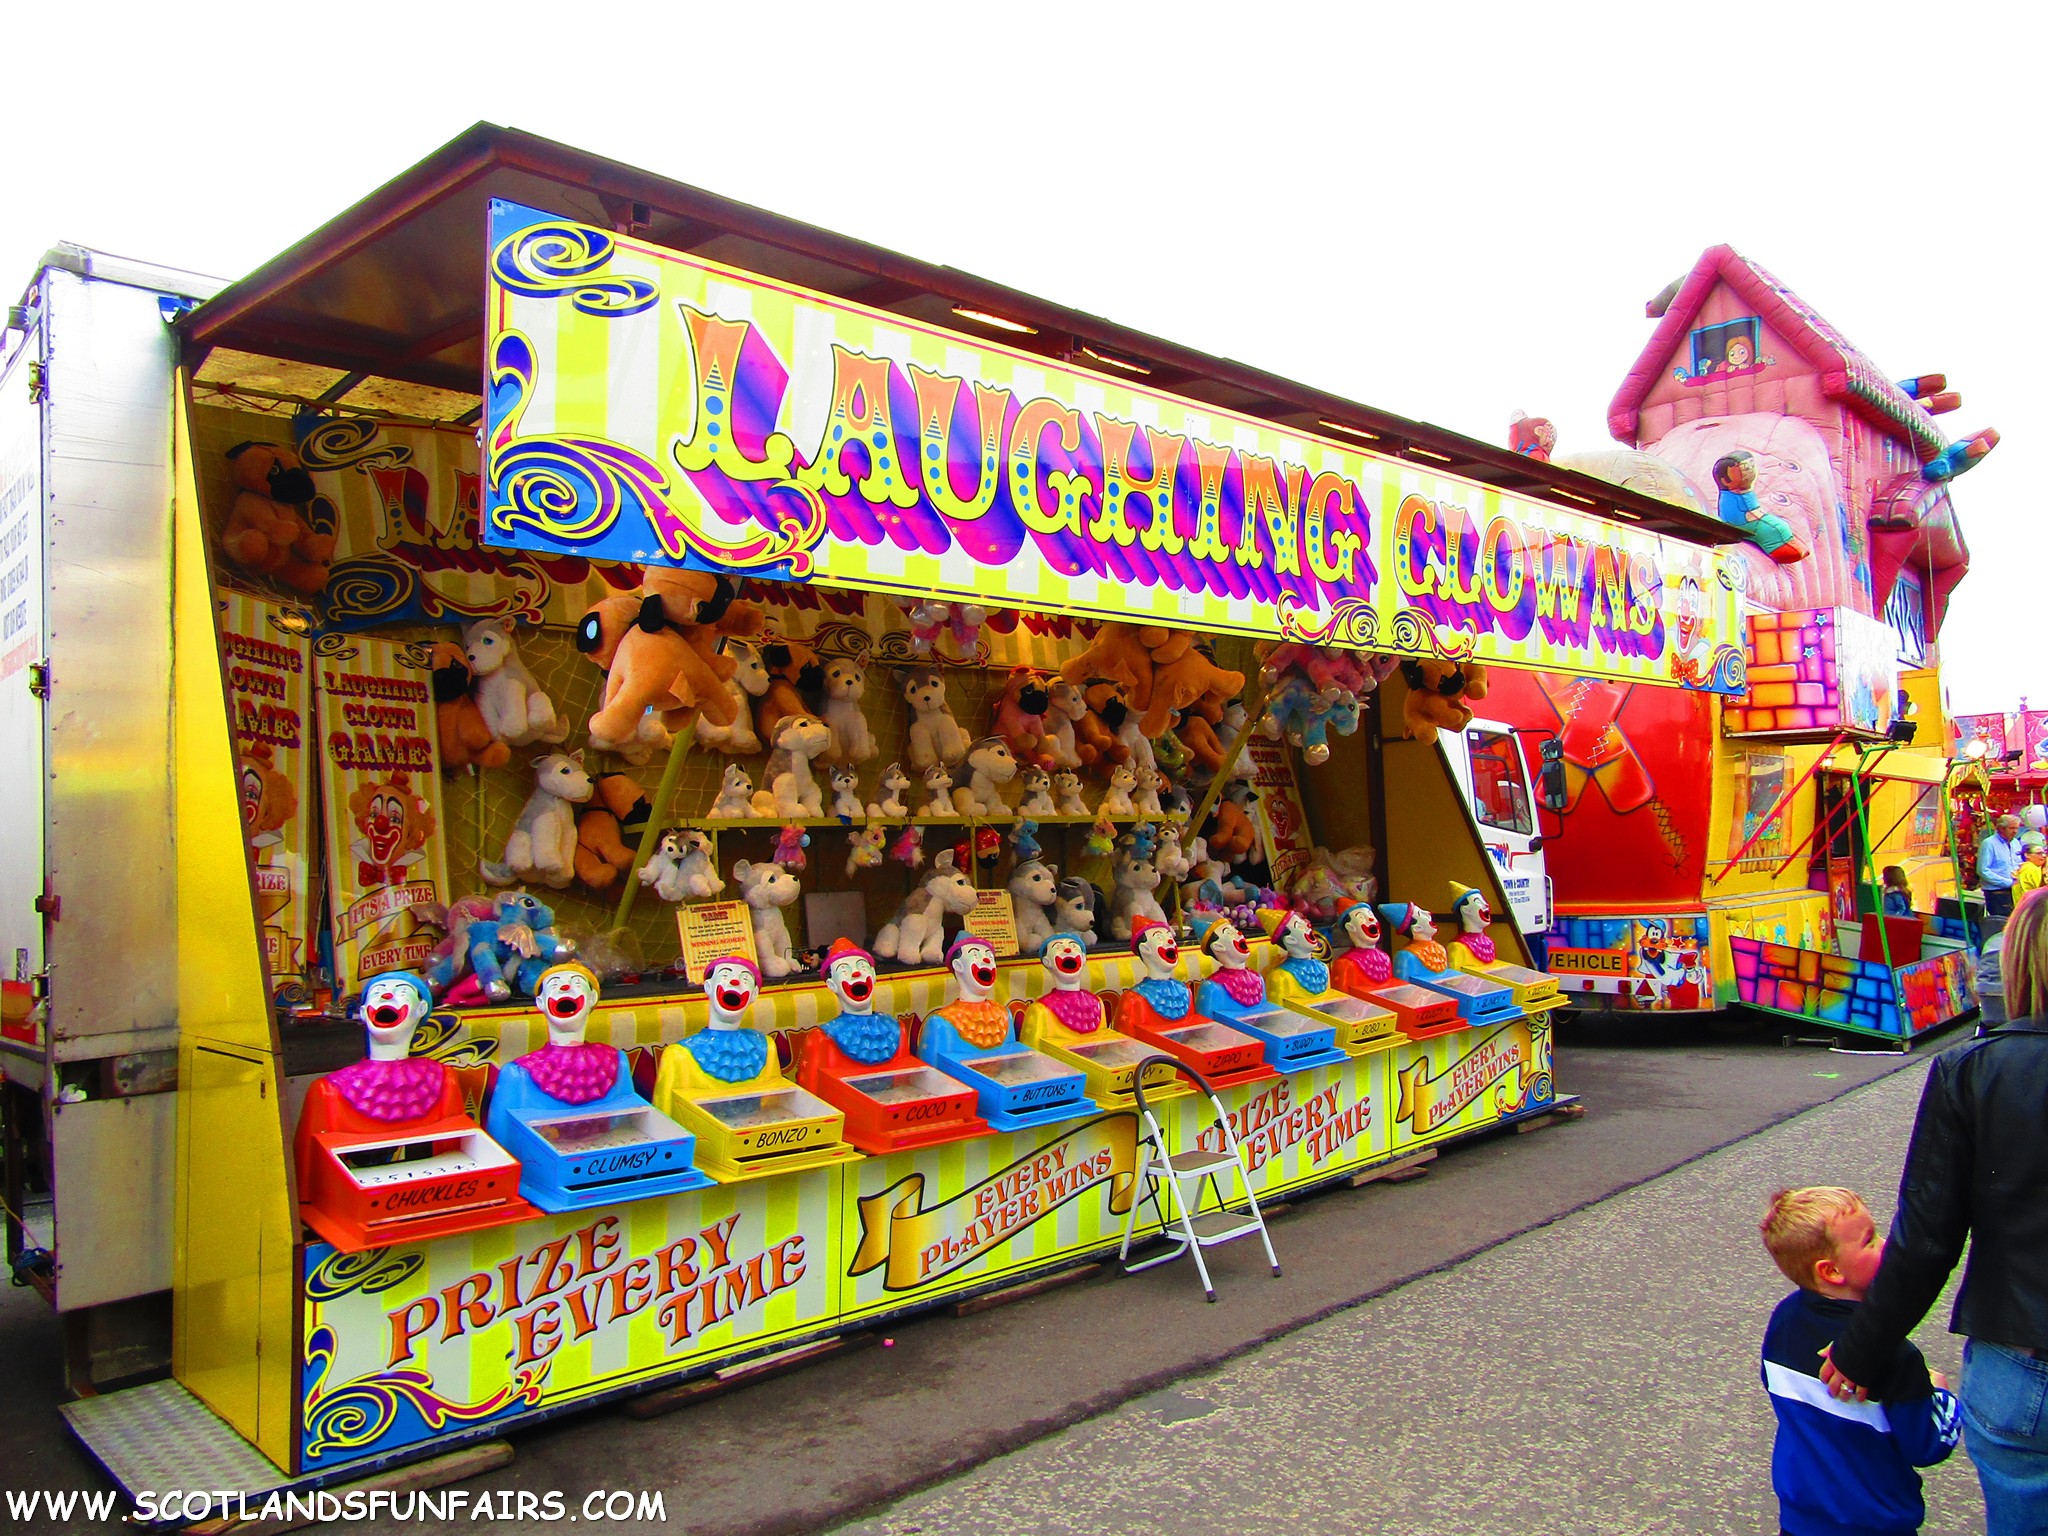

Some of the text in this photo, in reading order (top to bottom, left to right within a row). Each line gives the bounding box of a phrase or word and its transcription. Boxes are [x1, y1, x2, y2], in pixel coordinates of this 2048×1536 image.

[674, 303, 1664, 657] LAUGHING CLOWNS
[230, 666, 286, 700] OWN
[323, 671, 429, 703] LAUGHING
[236, 697, 300, 749] ME
[342, 703, 416, 730] CLOWN
[328, 731, 433, 773] GAME
[353, 899, 378, 924] IT'S
[394, 887, 433, 907] PRIZE
[362, 947, 402, 970] EVERY
[1213, 1052, 1241, 1069] ZIPPO
[1291, 1037, 1315, 1051] BUDDY
[1452, 1038, 1497, 1088] EVERY
[1022, 1083, 1068, 1102] BUTTONS
[1428, 1043, 1520, 1125] PLAYER WINS
[906, 1102, 947, 1121] COCO
[1246, 1080, 1341, 1175] EVERY
[1307, 1096, 1371, 1165] TIME
[756, 1126, 808, 1148] BONZO
[587, 1148, 658, 1176] CLUMSY
[974, 1142, 1069, 1219] EVERY
[385, 1179, 479, 1210] CHUCKLES
[920, 1147, 1112, 1278] PLAYER WINS
[387, 1216, 621, 1370] PRIZE
[512, 1213, 742, 1369] EVERY
[657, 1235, 807, 1347] TIME
